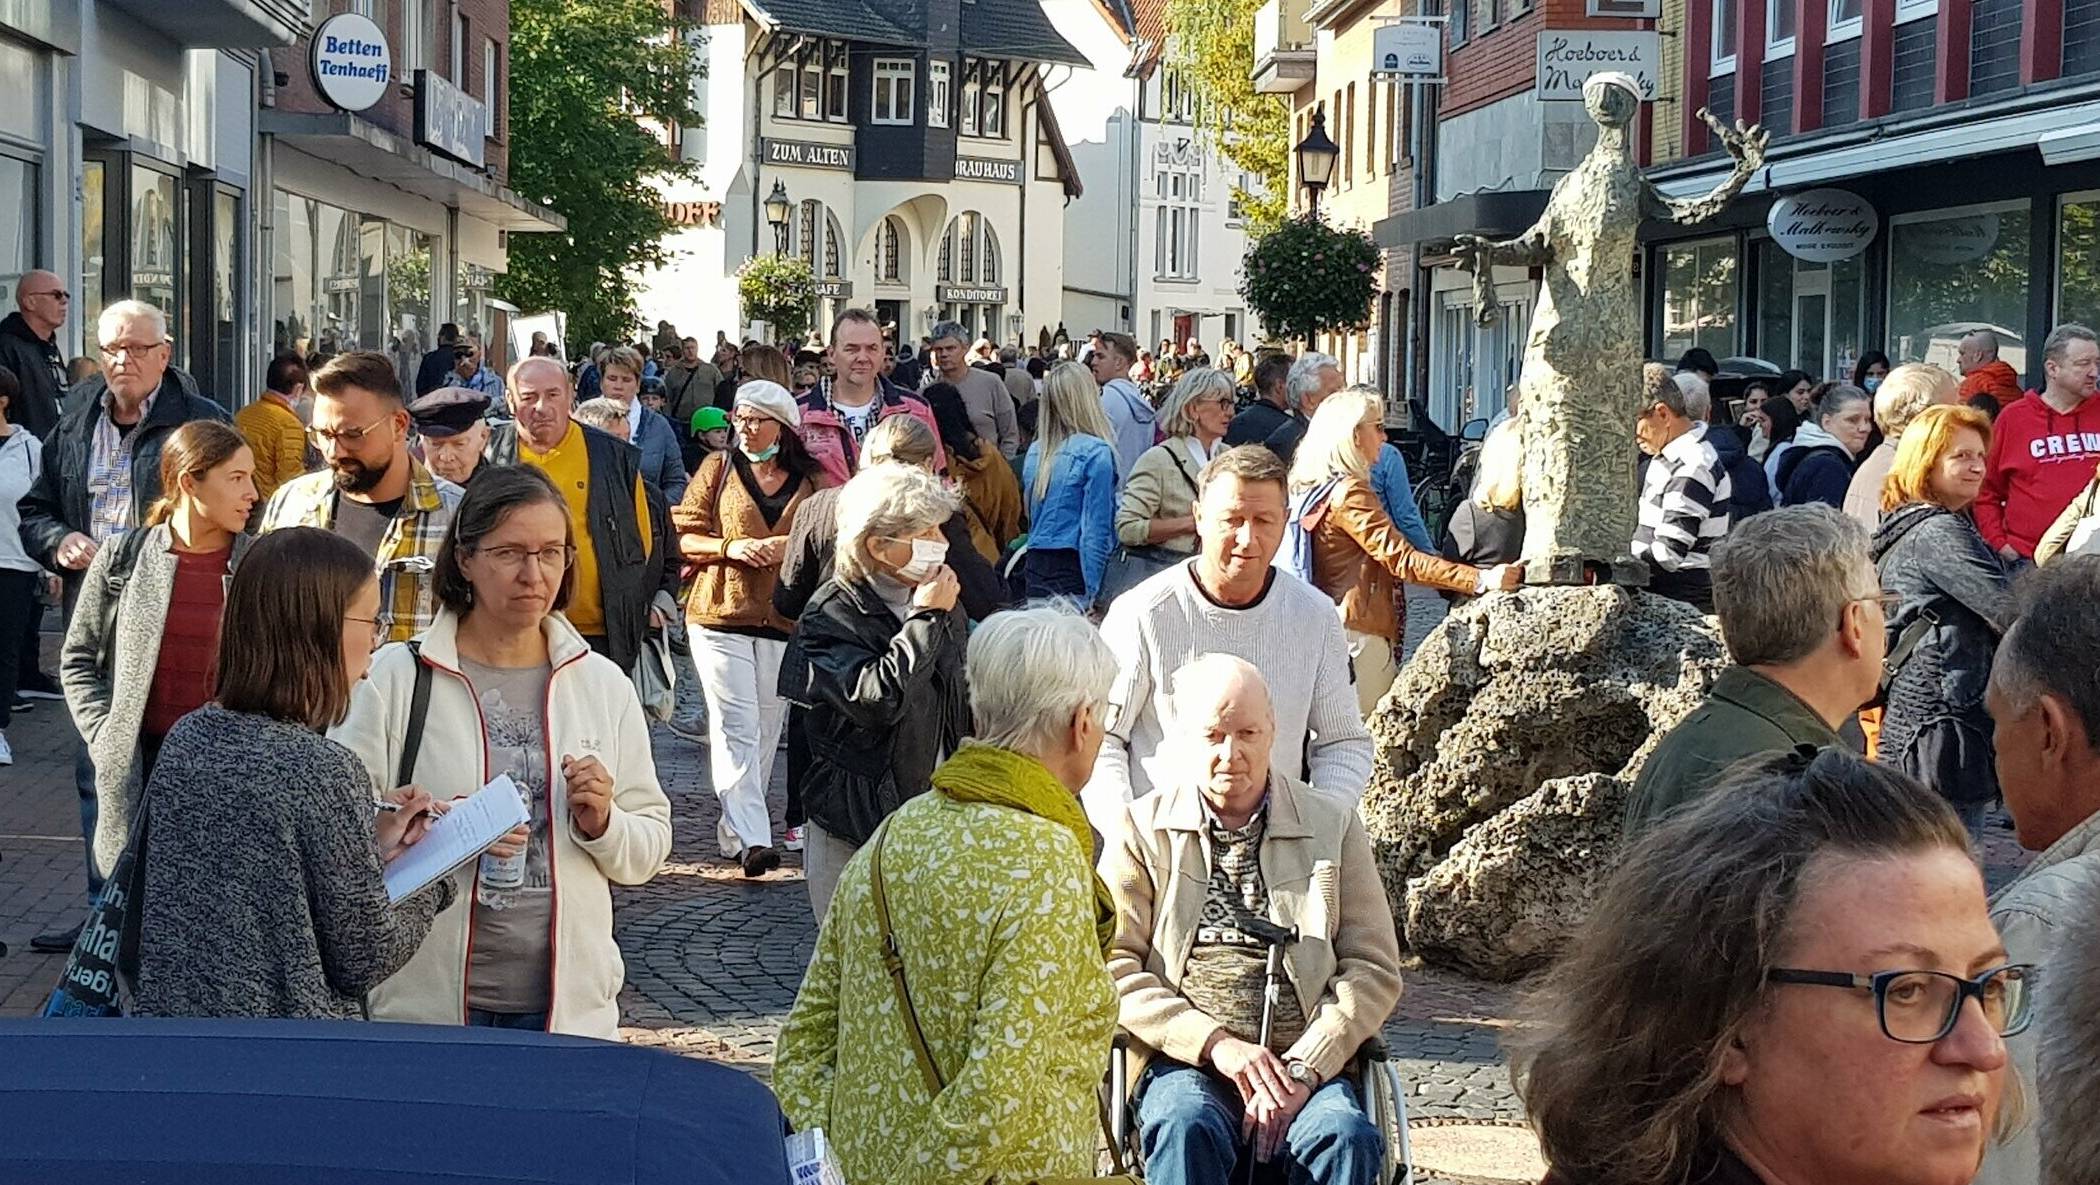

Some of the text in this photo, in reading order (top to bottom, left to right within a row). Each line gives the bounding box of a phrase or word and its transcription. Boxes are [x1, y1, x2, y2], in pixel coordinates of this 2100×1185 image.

[325, 36, 382, 57] Betten
[320, 60, 387, 82] Tenhaeff
[772, 143, 849, 166] ZUM ALTEN
[665, 201, 721, 225] OFF
[947, 288, 1001, 301] KONDITOREI
[2030, 432, 2100, 459] CREW
